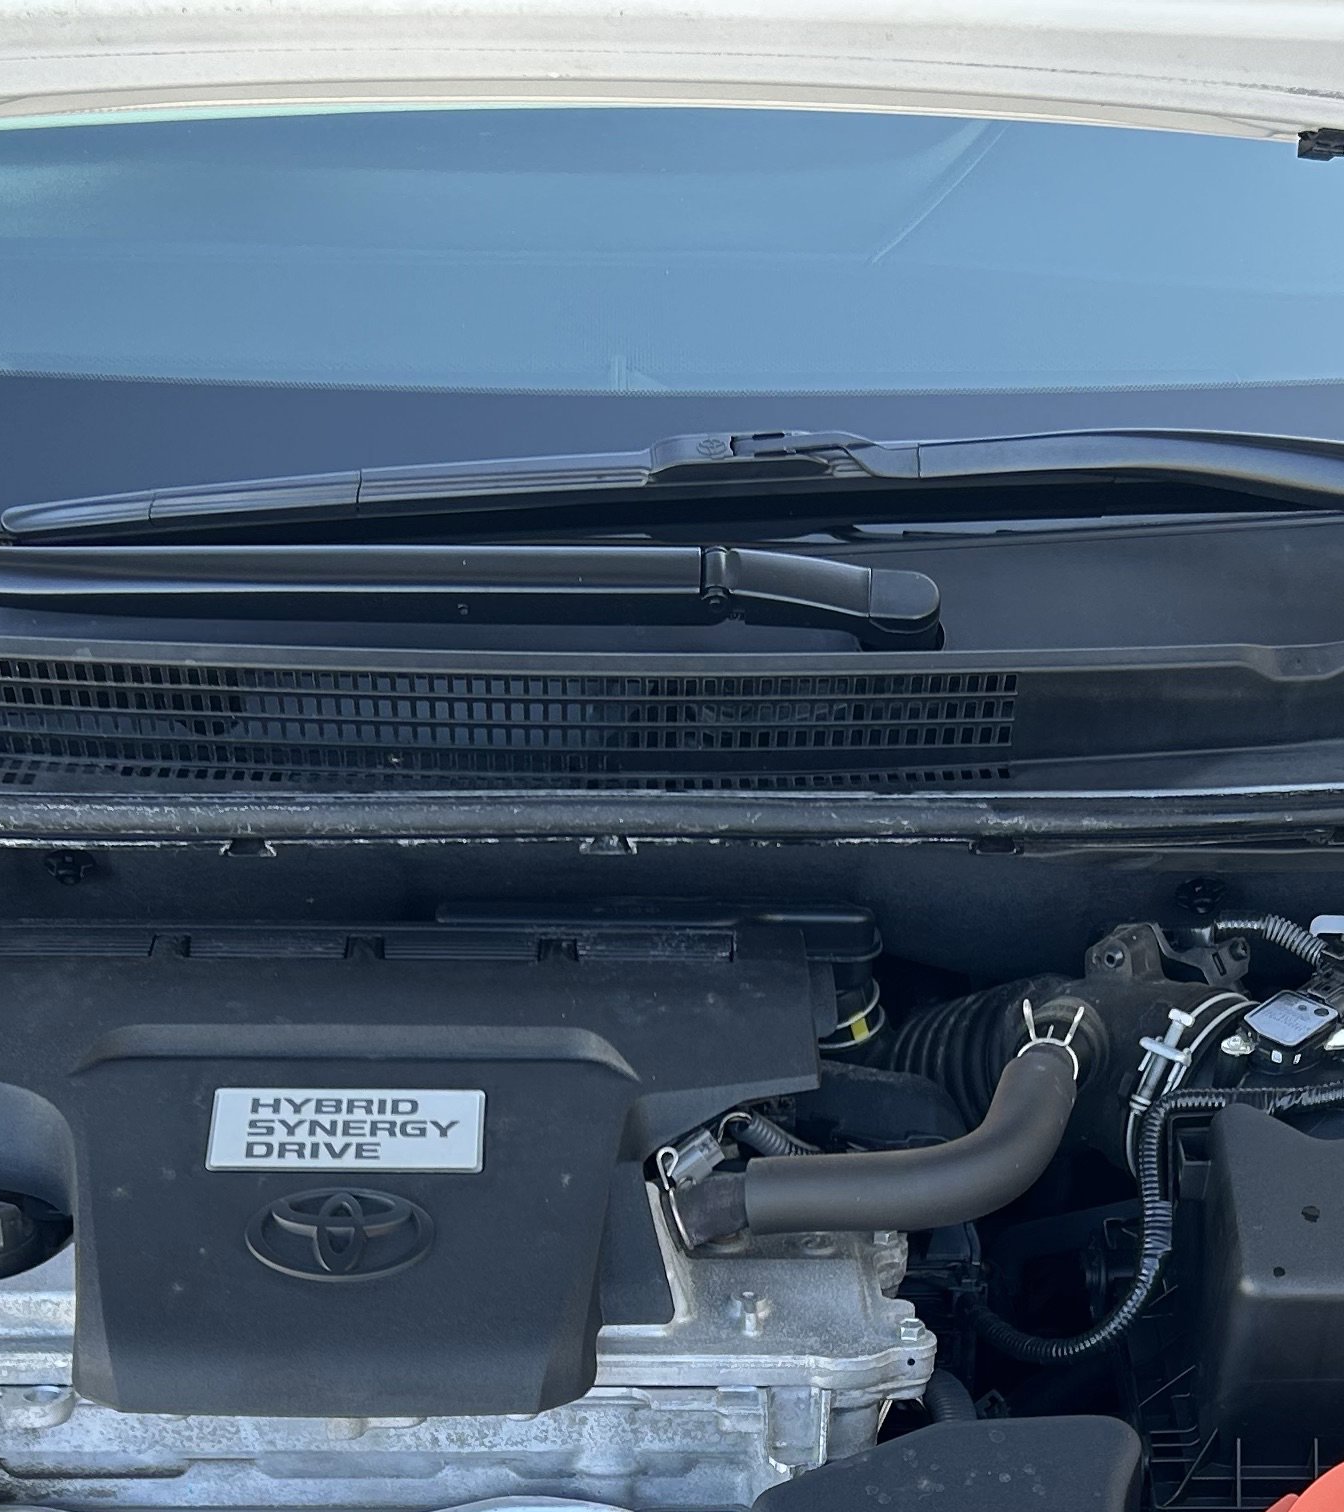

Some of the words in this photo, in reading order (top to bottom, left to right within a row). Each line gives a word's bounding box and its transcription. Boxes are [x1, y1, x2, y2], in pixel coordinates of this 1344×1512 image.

[250, 1097, 419, 1115] HYBRID
[247, 1119, 460, 1138] SYNERGY
[245, 1142, 382, 1160] DRIVE
